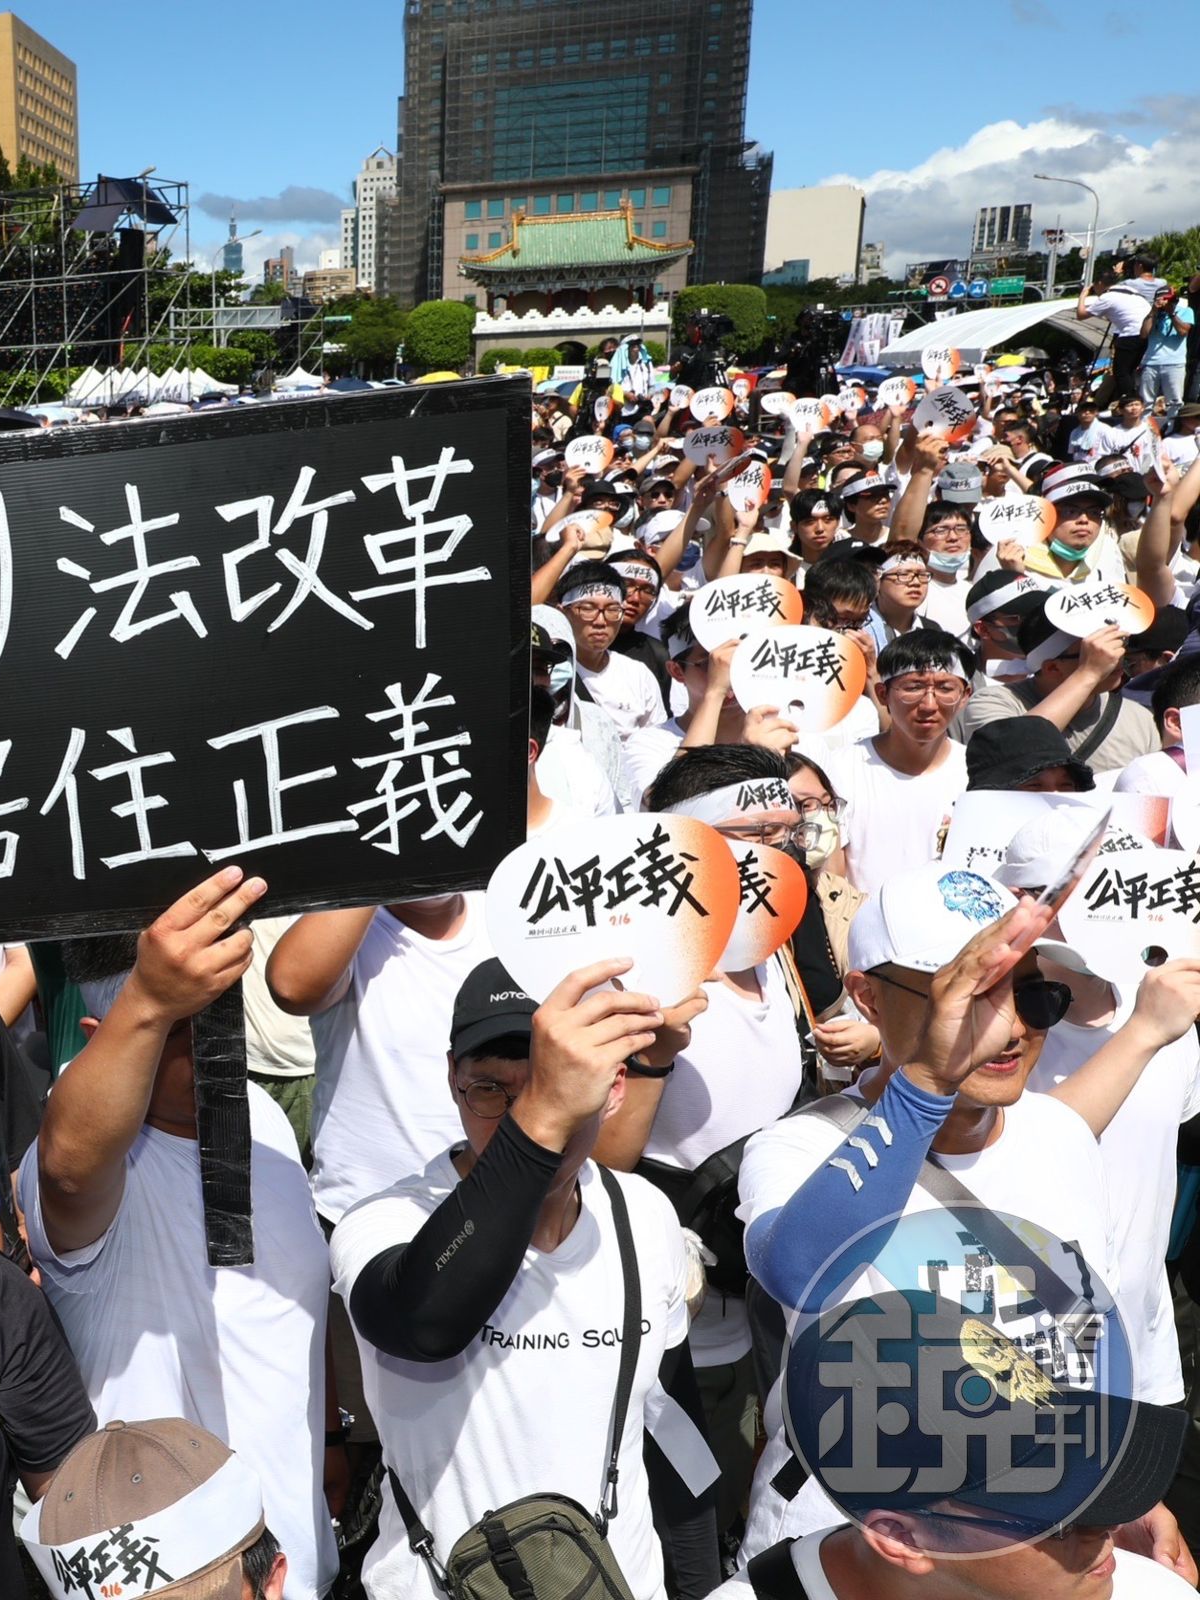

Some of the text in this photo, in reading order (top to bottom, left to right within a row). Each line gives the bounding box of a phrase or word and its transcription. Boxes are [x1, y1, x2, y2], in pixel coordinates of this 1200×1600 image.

[691, 428, 735, 447] 公平正義
[990, 499, 1046, 523] 公平正義
[705, 579, 788, 620] 公平正義
[1060, 584, 1141, 615] 公平正義
[750, 637, 847, 692] 公平正義
[519, 823, 709, 927] 公平正義
[1084, 859, 1200, 924] 公平正義
[480, 1319, 651, 1350] TRAINING SQUD
[50, 1522, 176, 1600] 公平正義
